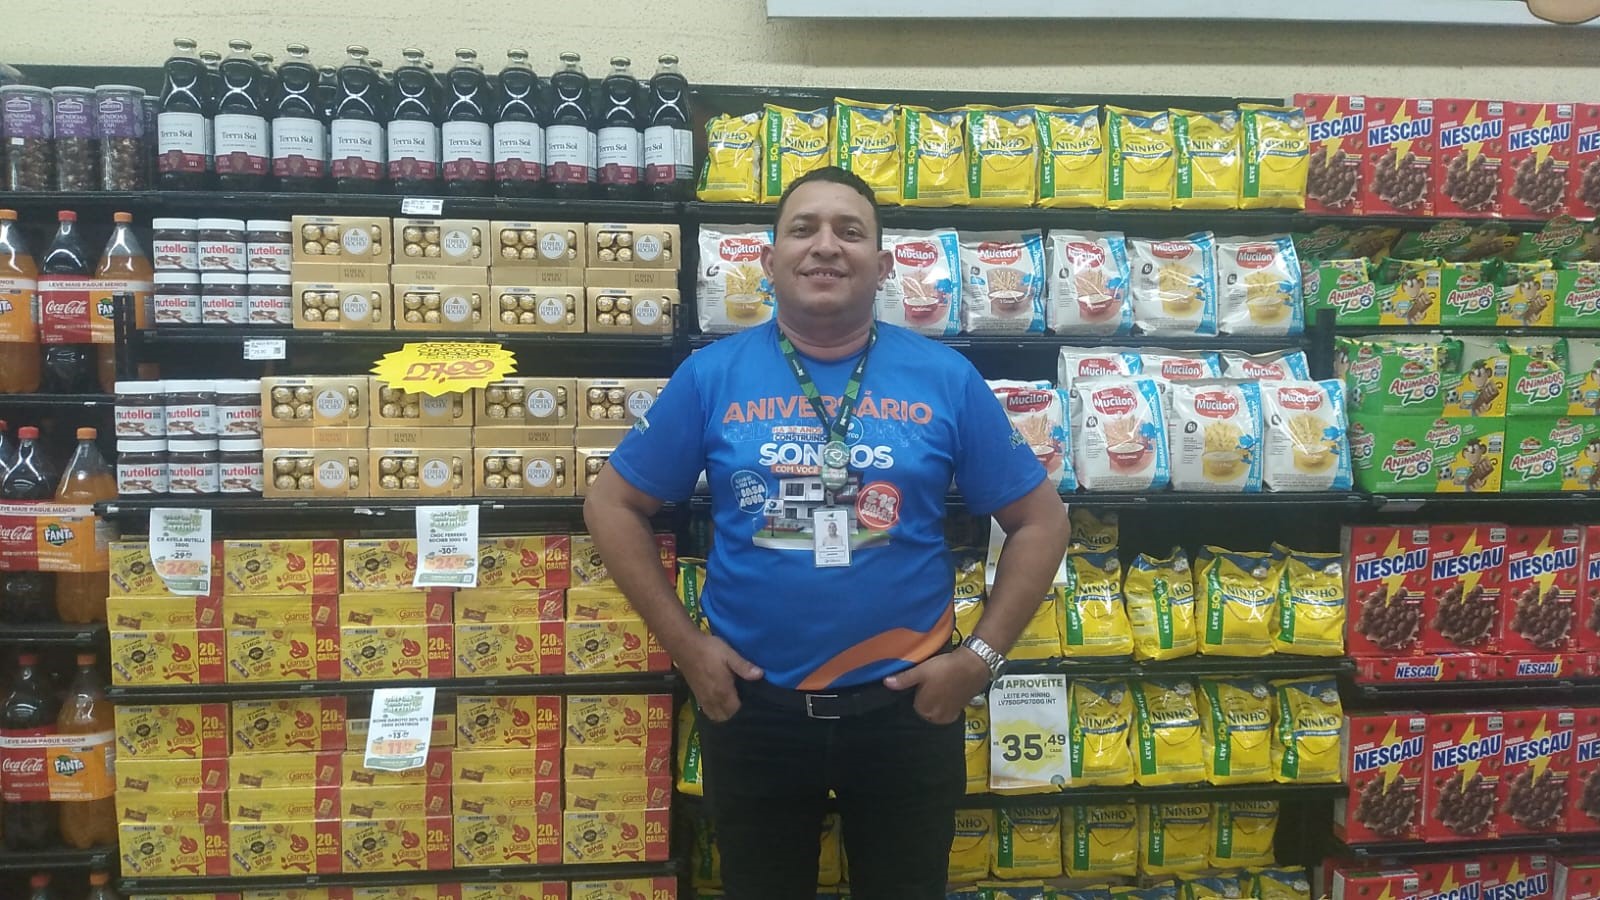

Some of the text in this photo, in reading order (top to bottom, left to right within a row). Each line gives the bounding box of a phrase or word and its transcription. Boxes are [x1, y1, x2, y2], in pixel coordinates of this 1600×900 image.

[160, 129, 193, 138] Terra Sol
[222, 130, 257, 141] Terra Sol
[711, 130, 748, 141] NINHO
[1368, 117, 1433, 147] NESCAU
[1440, 119, 1503, 147] NESCAU
[1509, 122, 1571, 151] NESCAU
[279, 134, 314, 144] Terra Sol
[338, 136, 373, 146] Terra Sol
[393, 136, 426, 146] Terra Sol
[498, 138, 532, 147] Terra Sol
[784, 136, 821, 149] NINHO
[855, 135, 890, 147] NINHO
[986, 138, 1025, 150] NINHO
[1056, 137, 1095, 150] NINHO
[1125, 142, 1164, 152] NINHO
[1263, 140, 1301, 151] NINHO
[155, 245, 189, 254] nutella
[200, 246, 237, 254] nutella
[249, 247, 284, 256] nutella
[979, 249, 1019, 259] Mucilon
[1238, 252, 1273, 262] Mucilon
[155, 299, 188, 308] nutella
[202, 299, 235, 308] nutella
[250, 300, 284, 309] nutella
[1162, 365, 1200, 376] Mucilon
[1009, 393, 1050, 406] Mucilon
[1094, 396, 1135, 408] Mucilon
[1197, 400, 1236, 410] Mucilon
[723, 390, 933, 425] ANIVERÁRIO
[116, 410, 153, 420] nutella
[167, 409, 201, 419] nutella
[759, 443, 895, 470] SONOS
[120, 467, 161, 478] nutella
[170, 467, 205, 477] nutella
[221, 467, 259, 477] nutella
[775, 466, 794, 474] COM
[45, 528, 74, 542] FANTA
[1356, 548, 1428, 582] NESCAU
[1433, 546, 1505, 580] NESCAU
[1509, 547, 1577, 581] NESCAU
[1078, 582, 1118, 594] NINHO
[1225, 585, 1267, 598] NINHO
[1297, 586, 1338, 598] NINHO
[1211, 610, 1219, 631] LEVE
[1395, 665, 1439, 679] NESCAU
[1517, 663, 1560, 676] NESCAU
[1005, 678, 1063, 688] APROVEITE
[1151, 708, 1192, 721] NINHO
[1228, 709, 1266, 721] NINHO
[1298, 715, 1337, 728] NINHO
[1354, 736, 1424, 772] NESCAU
[1432, 734, 1502, 771] NESCAU
[1504, 730, 1573, 766] NESCAU
[54, 759, 85, 772] FANTA
[1483, 874, 1548, 900] NESCAU
